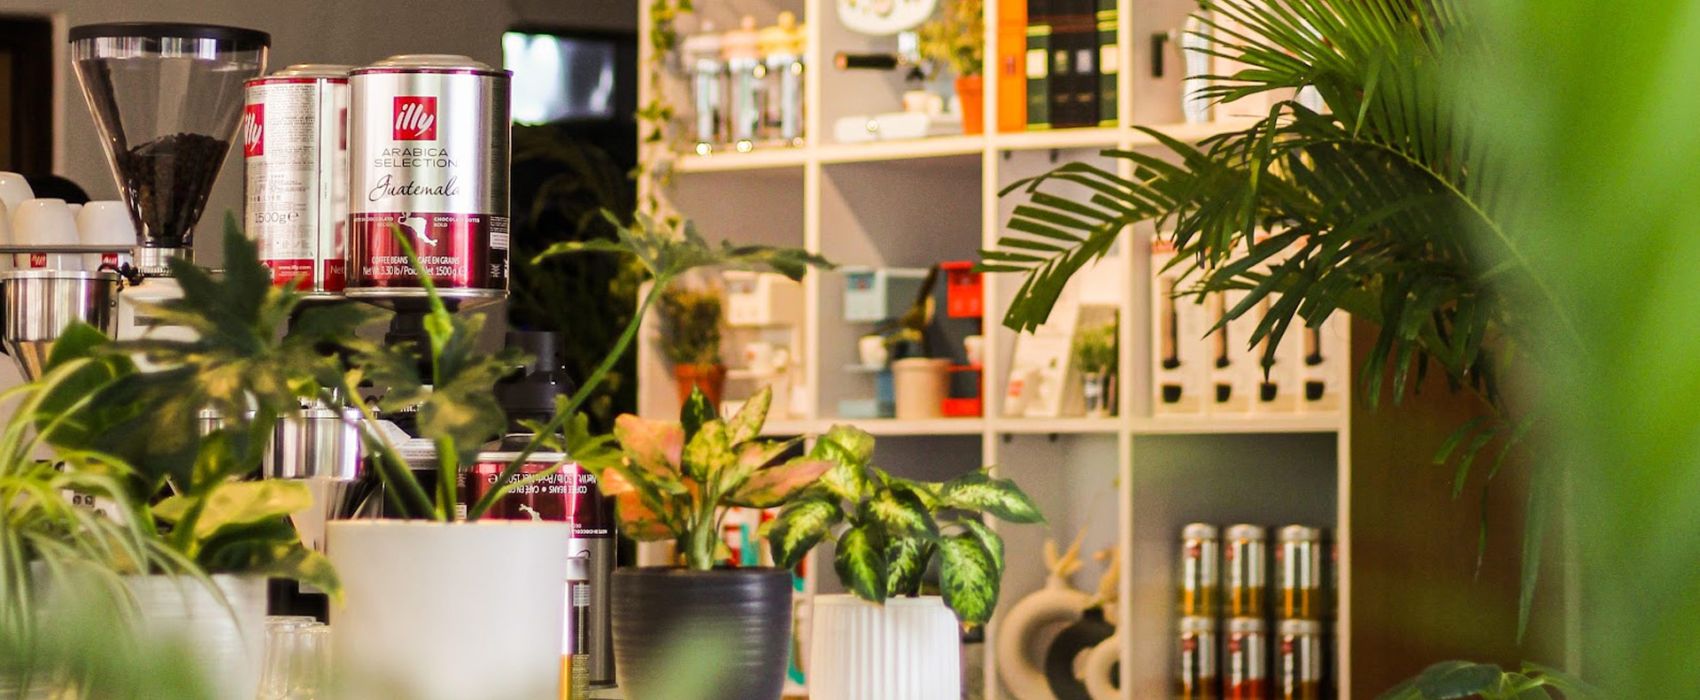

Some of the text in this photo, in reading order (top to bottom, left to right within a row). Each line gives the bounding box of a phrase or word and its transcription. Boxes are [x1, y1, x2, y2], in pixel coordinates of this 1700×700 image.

[395, 102, 435, 137] illy
[382, 148, 448, 157] ARABICA
[374, 158, 458, 168] SELECTION
[368, 174, 459, 202] Guatemala
[372, 256, 390, 264] COFFEE
[390, 256, 408, 264] BEANS
[440, 256, 460, 264] GRAINS
[549, 485, 568, 494] BEANS
